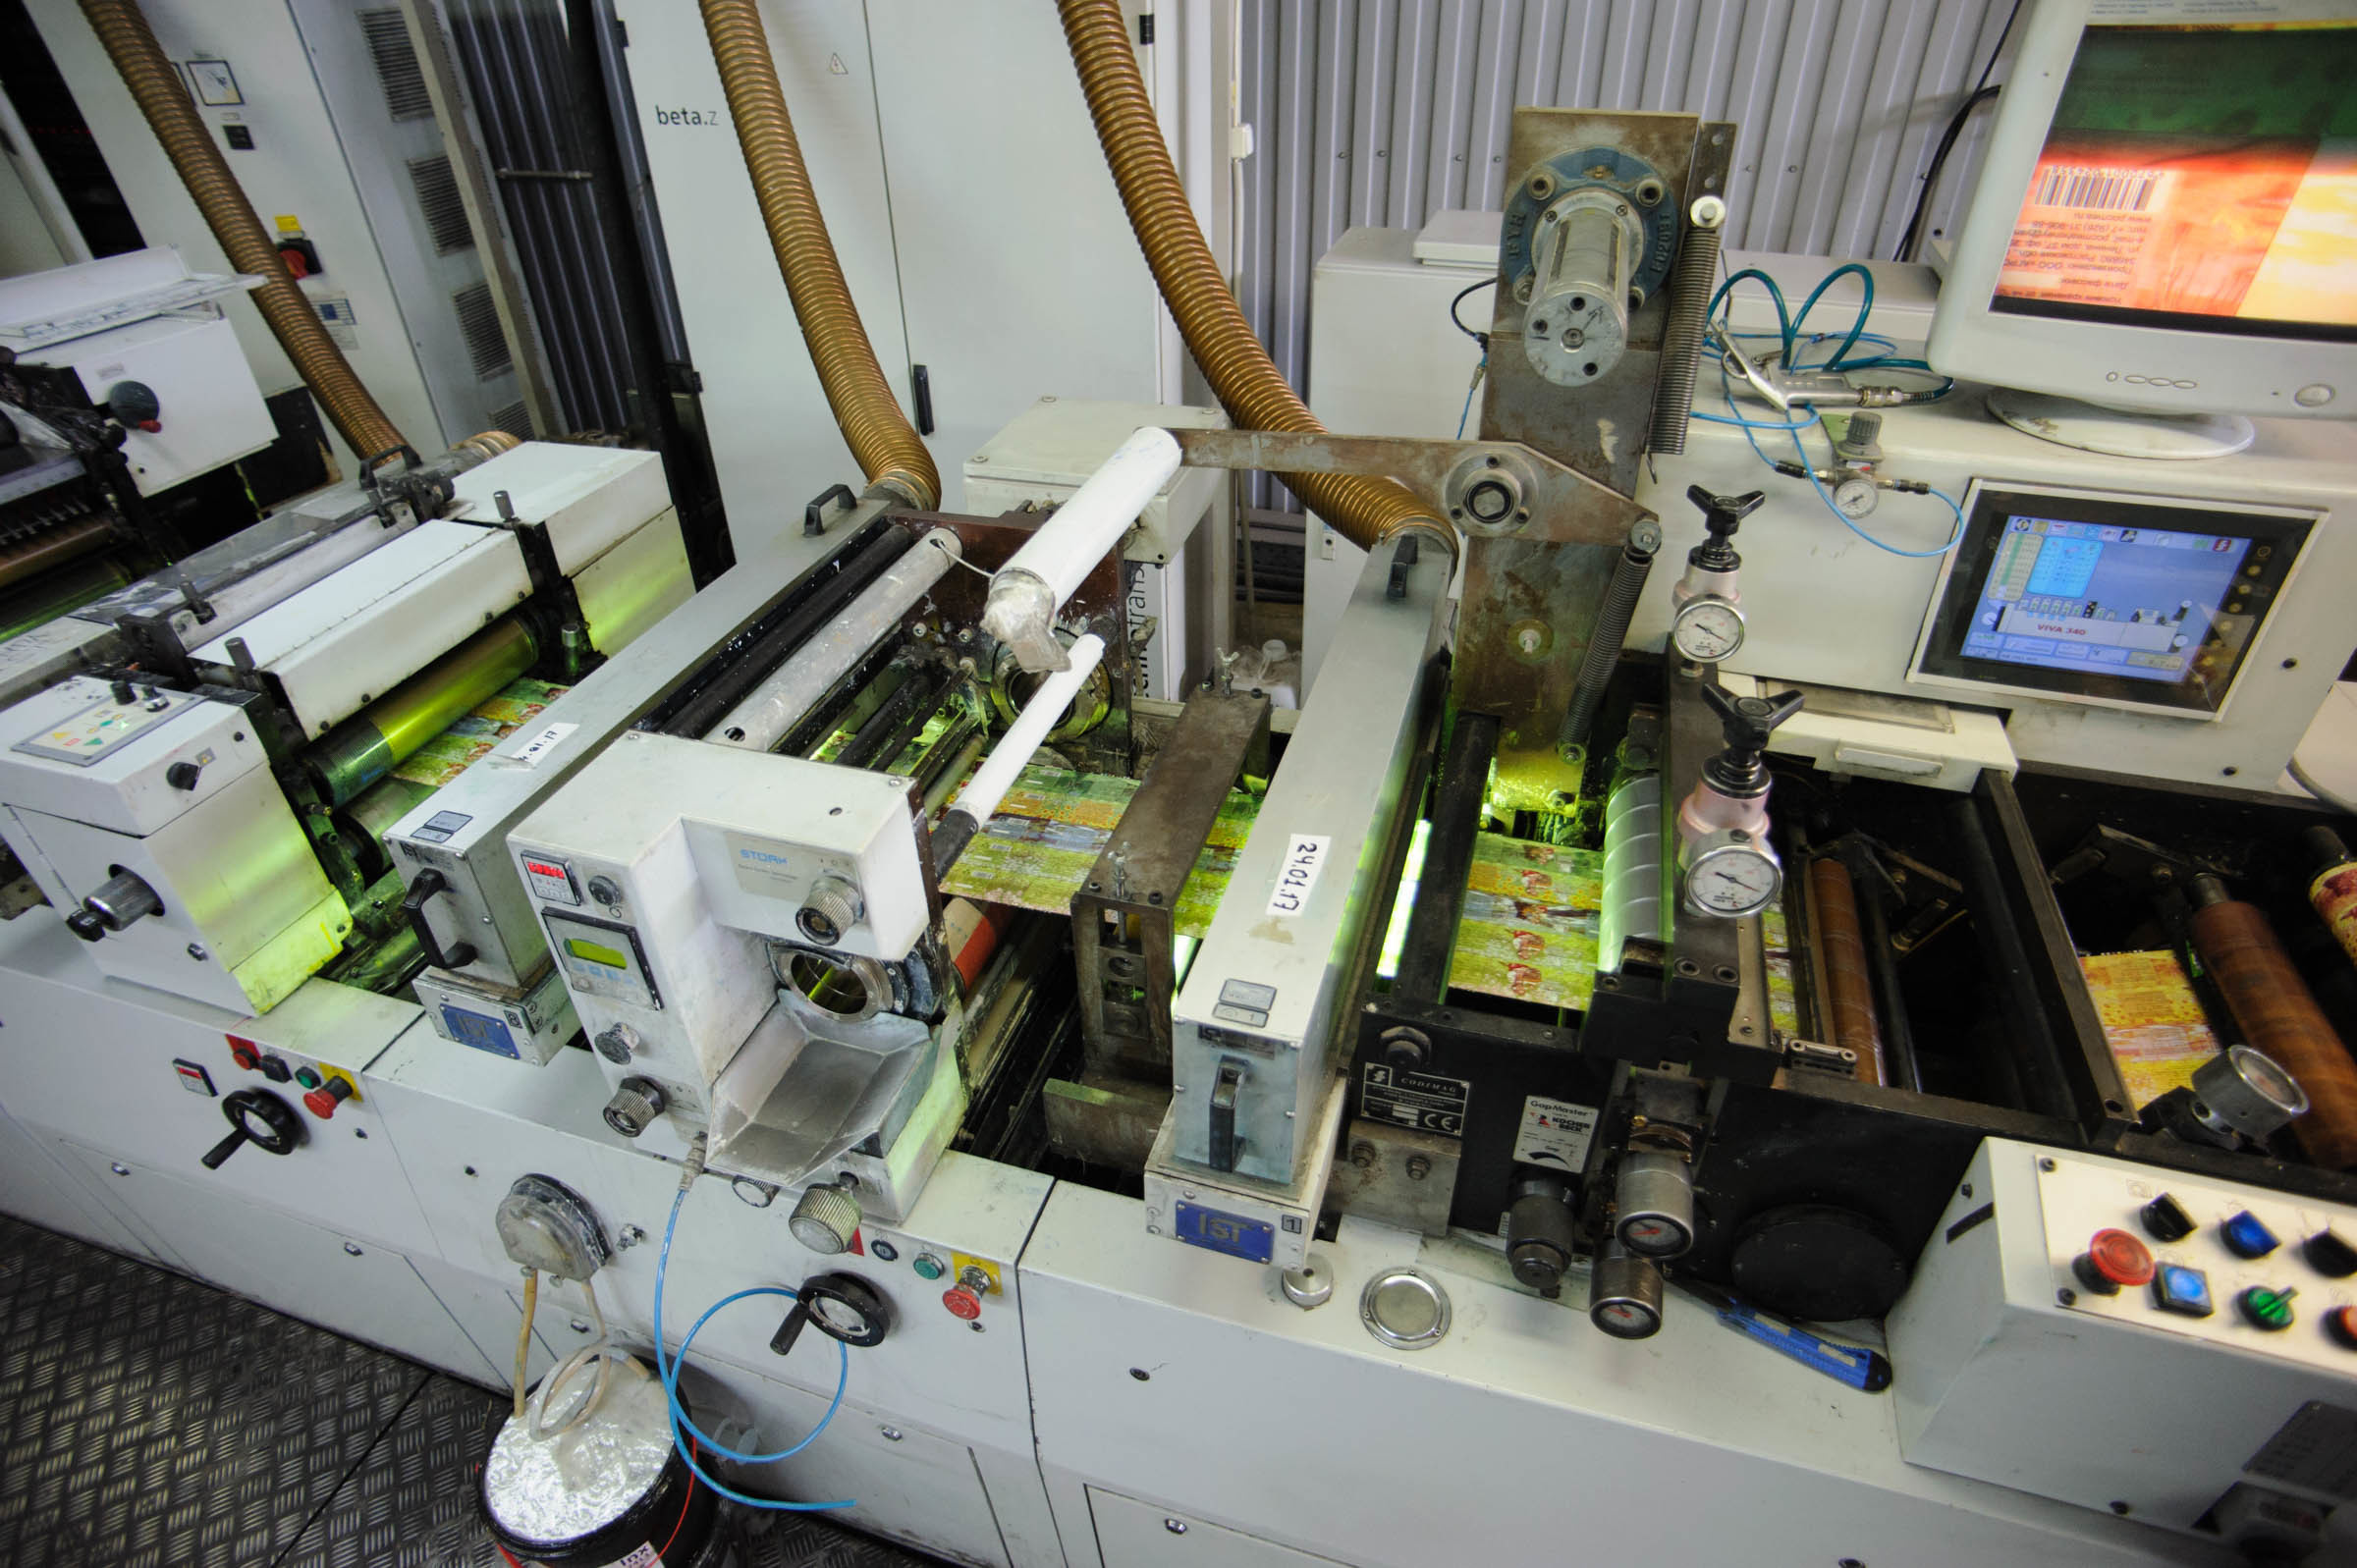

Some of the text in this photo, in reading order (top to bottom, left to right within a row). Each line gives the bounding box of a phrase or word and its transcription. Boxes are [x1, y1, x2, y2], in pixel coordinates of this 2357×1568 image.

[655, 104, 719, 126] beta.z
[2037, 623, 2062, 633] VIVA
[740, 848, 789, 867] STORK
[1273, 841, 1318, 913] 24.01.17
[1400, 1076, 1457, 1094] CODIMAG
[1198, 1211, 1243, 1243] IST
[1287, 1217, 1297, 1232] 1
